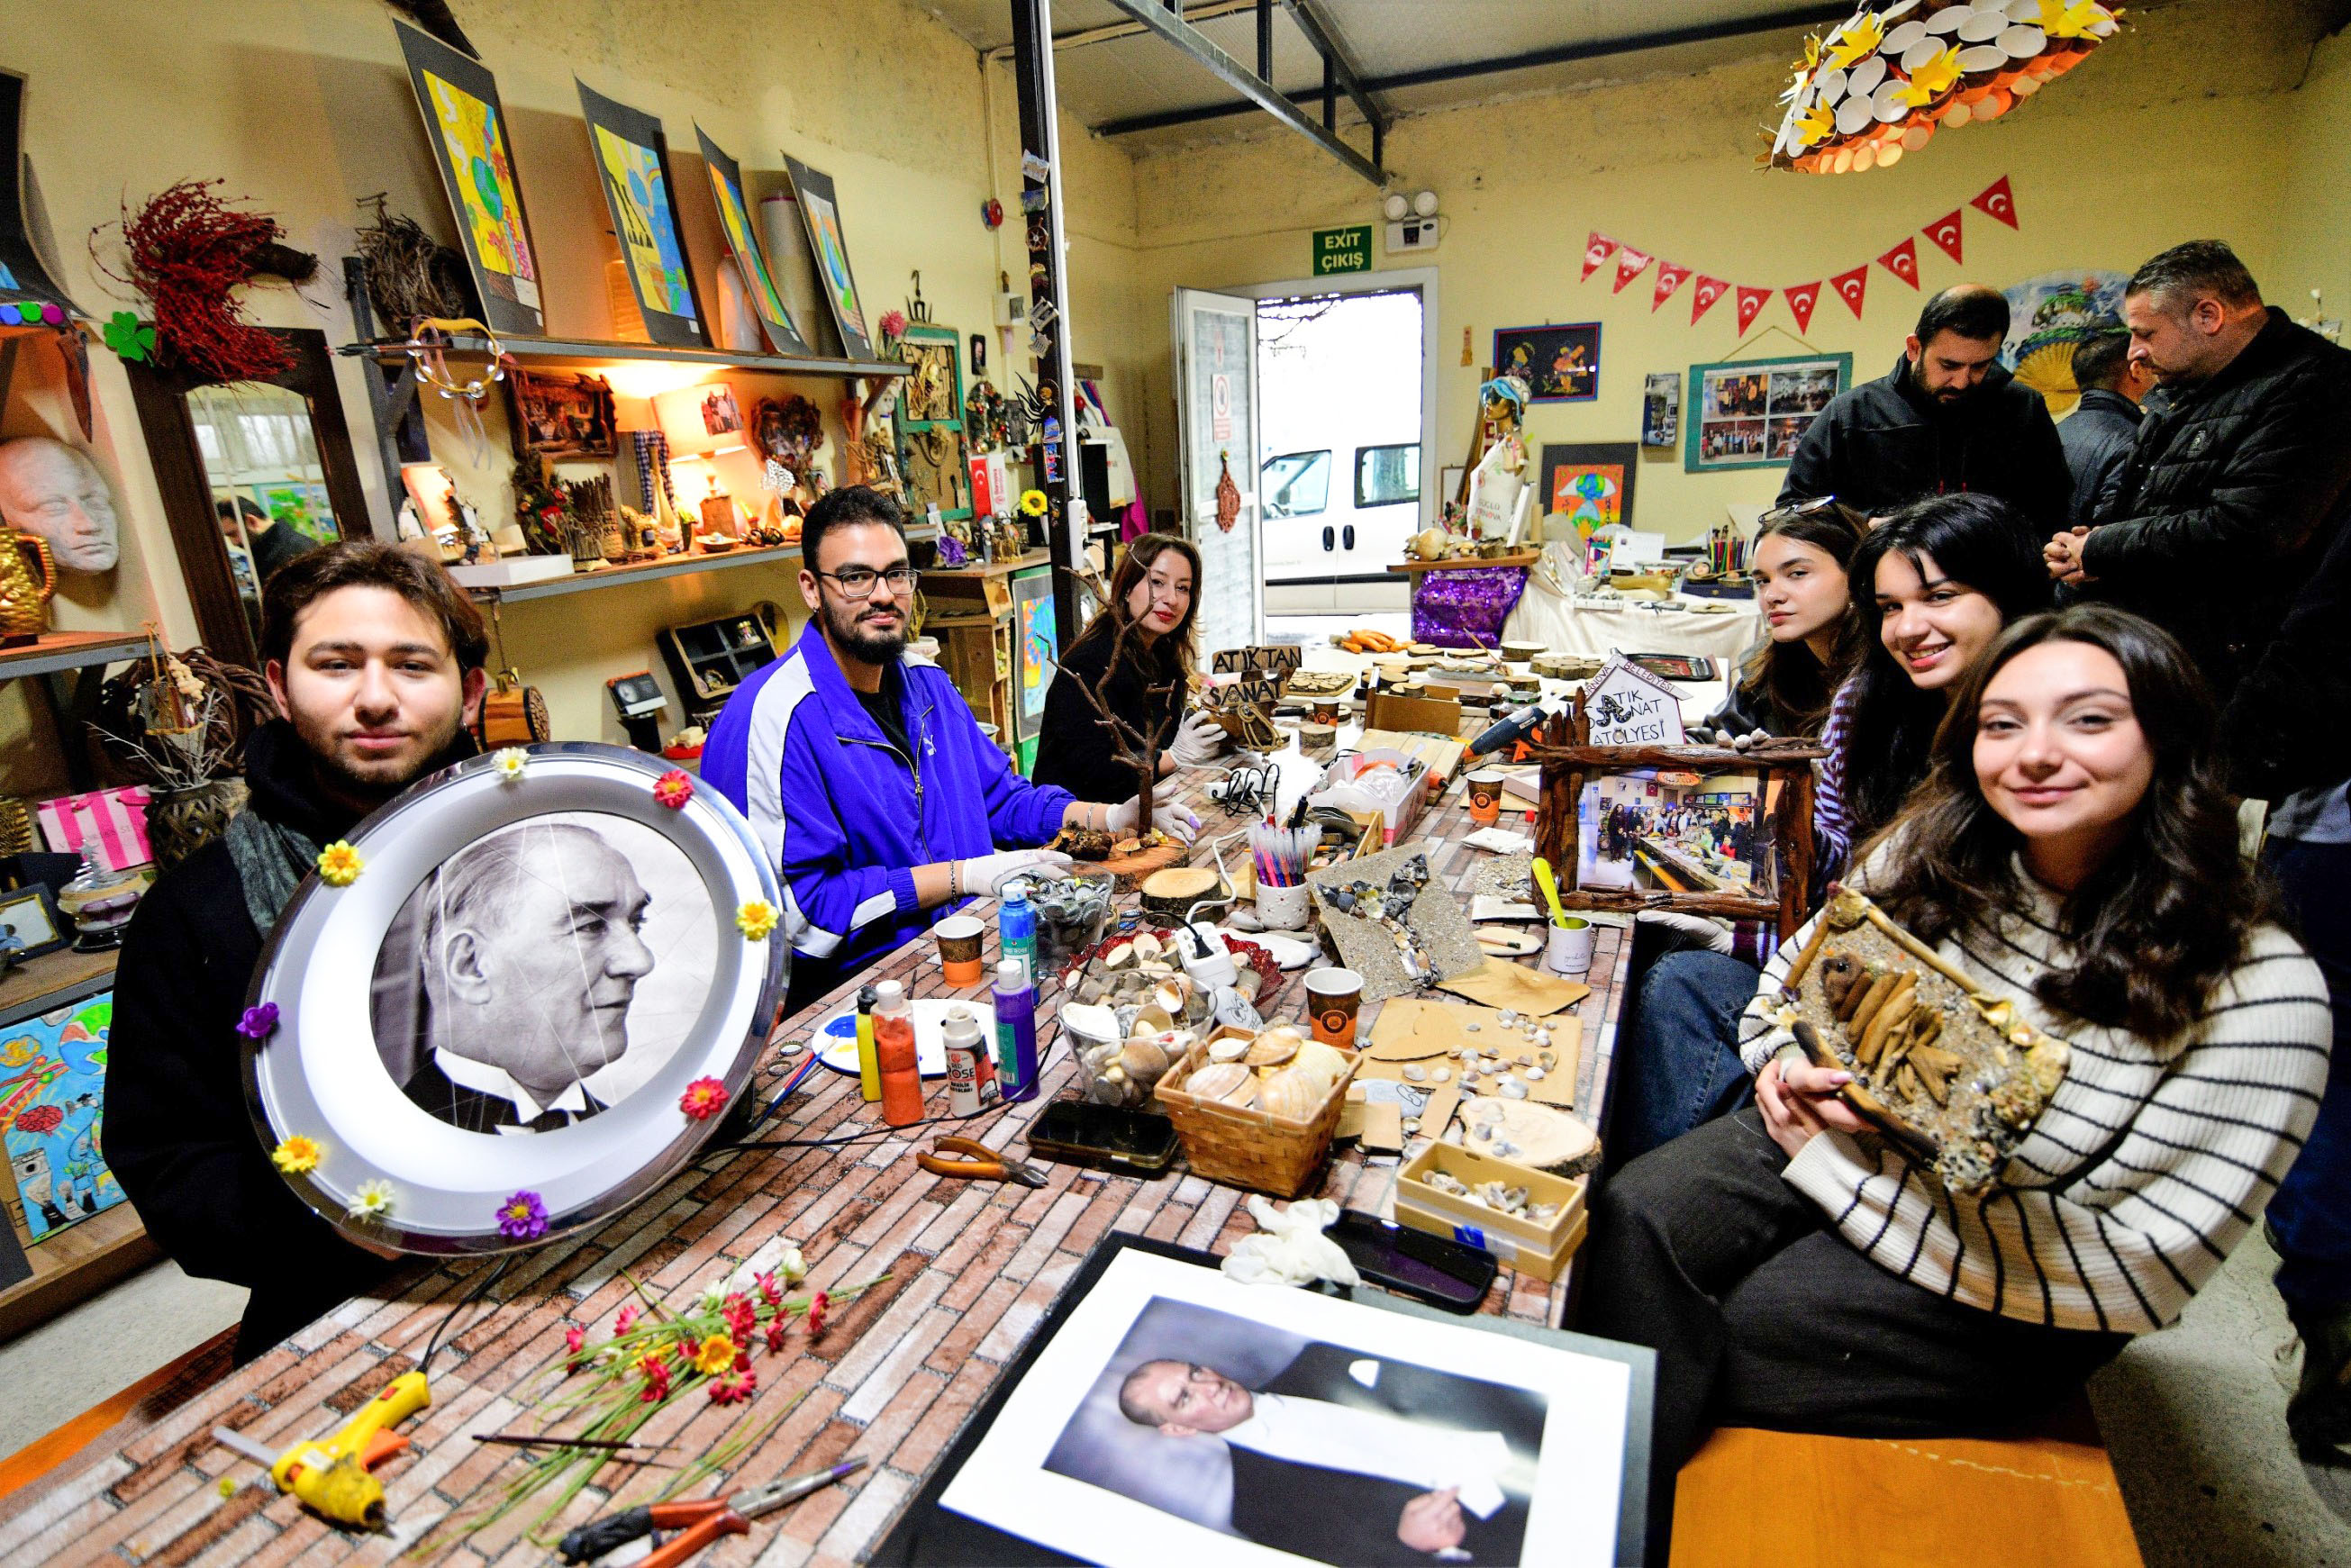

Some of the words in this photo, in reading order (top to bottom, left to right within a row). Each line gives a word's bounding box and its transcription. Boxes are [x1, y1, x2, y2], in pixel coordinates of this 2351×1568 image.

[1325, 232, 1361, 249] EXIT
[1321, 251, 1364, 272] ÇIKIŞ
[1210, 676, 1286, 706] SANAT
[1584, 665, 1612, 698] ORNOVA
